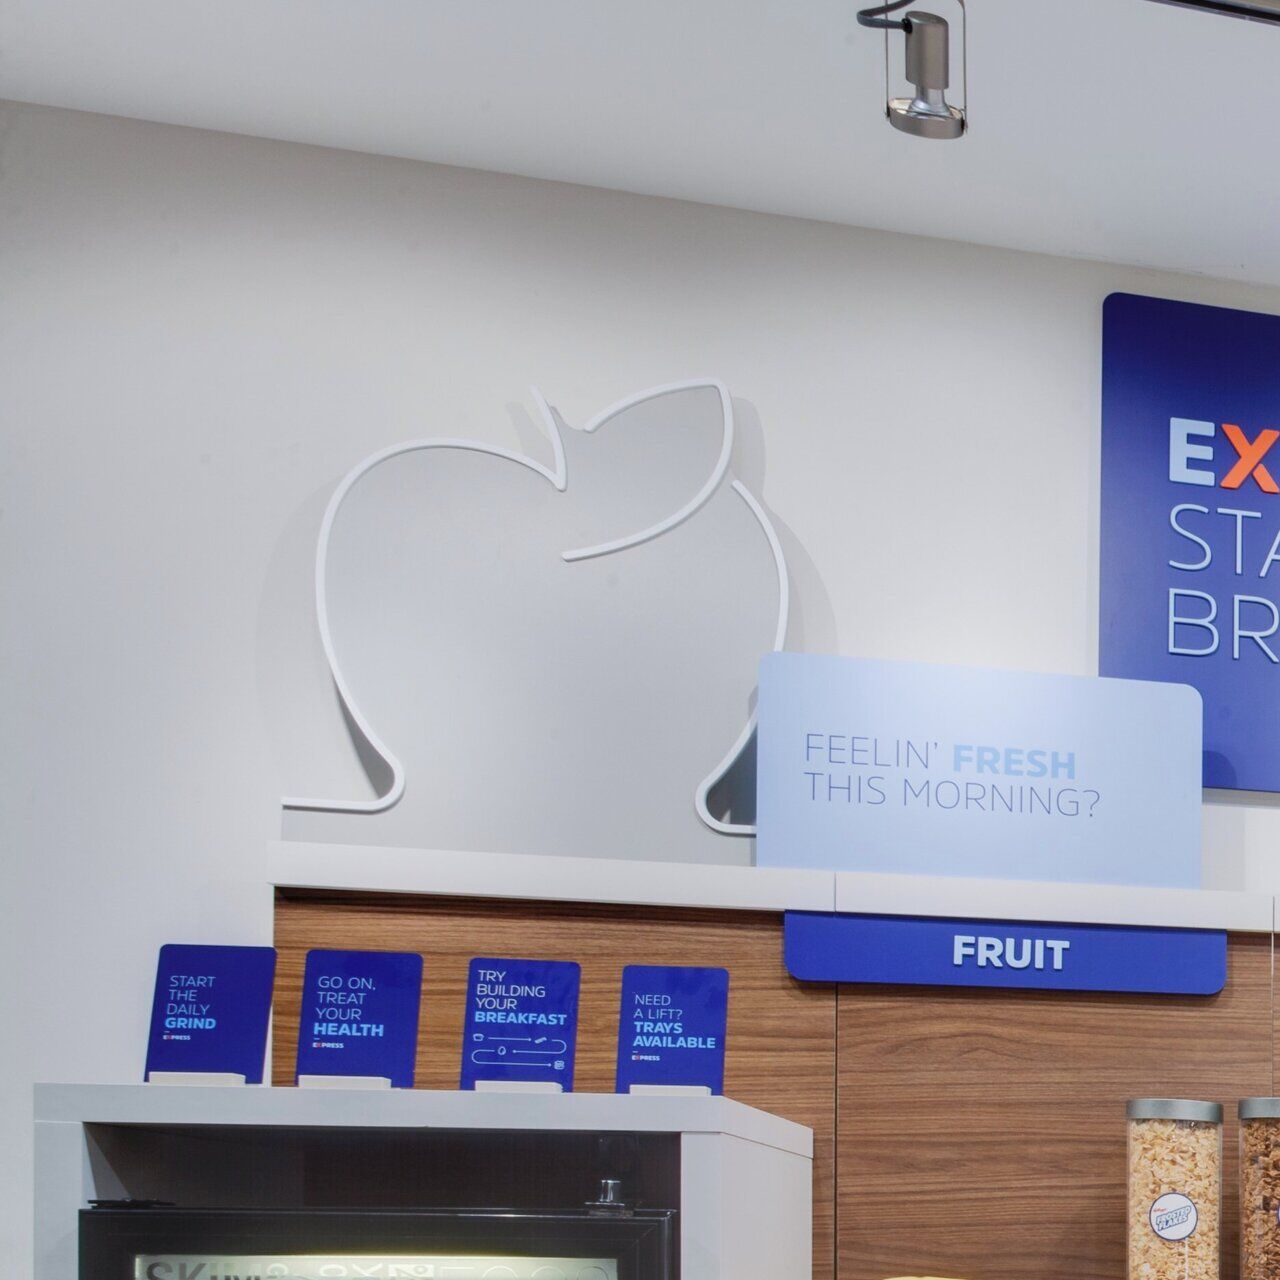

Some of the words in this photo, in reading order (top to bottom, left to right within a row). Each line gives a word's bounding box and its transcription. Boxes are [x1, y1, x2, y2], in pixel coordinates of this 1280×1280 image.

[805, 733, 939, 770] FEELIN'
[953, 744, 1077, 780] FRESH
[804, 772, 886, 806] THIS
[903, 779, 1101, 818] MORNING?
[953, 934, 1070, 971] FRUIT
[170, 975, 216, 988] START
[478, 969, 506, 983] TRY
[318, 976, 343, 990] GO
[348, 977, 376, 991] ON,
[168, 989, 198, 1001] THE
[317, 991, 367, 1005] TREAT
[476, 984, 546, 998] BUILDING
[475, 997, 517, 1010] YOUR
[634, 994, 671, 1006] NEED
[166, 1003, 210, 1015] DAILY
[315, 1007, 362, 1021] YOUR
[633, 1008, 644, 1020] A
[648, 1009, 683, 1021] LIFT?
[165, 1017, 217, 1030] GRIND
[474, 1011, 567, 1026] BREAKFAST
[313, 1022, 384, 1037] HEALTH
[634, 1021, 683, 1034] TRAYS
[633, 1035, 716, 1049] AVAILABLE
